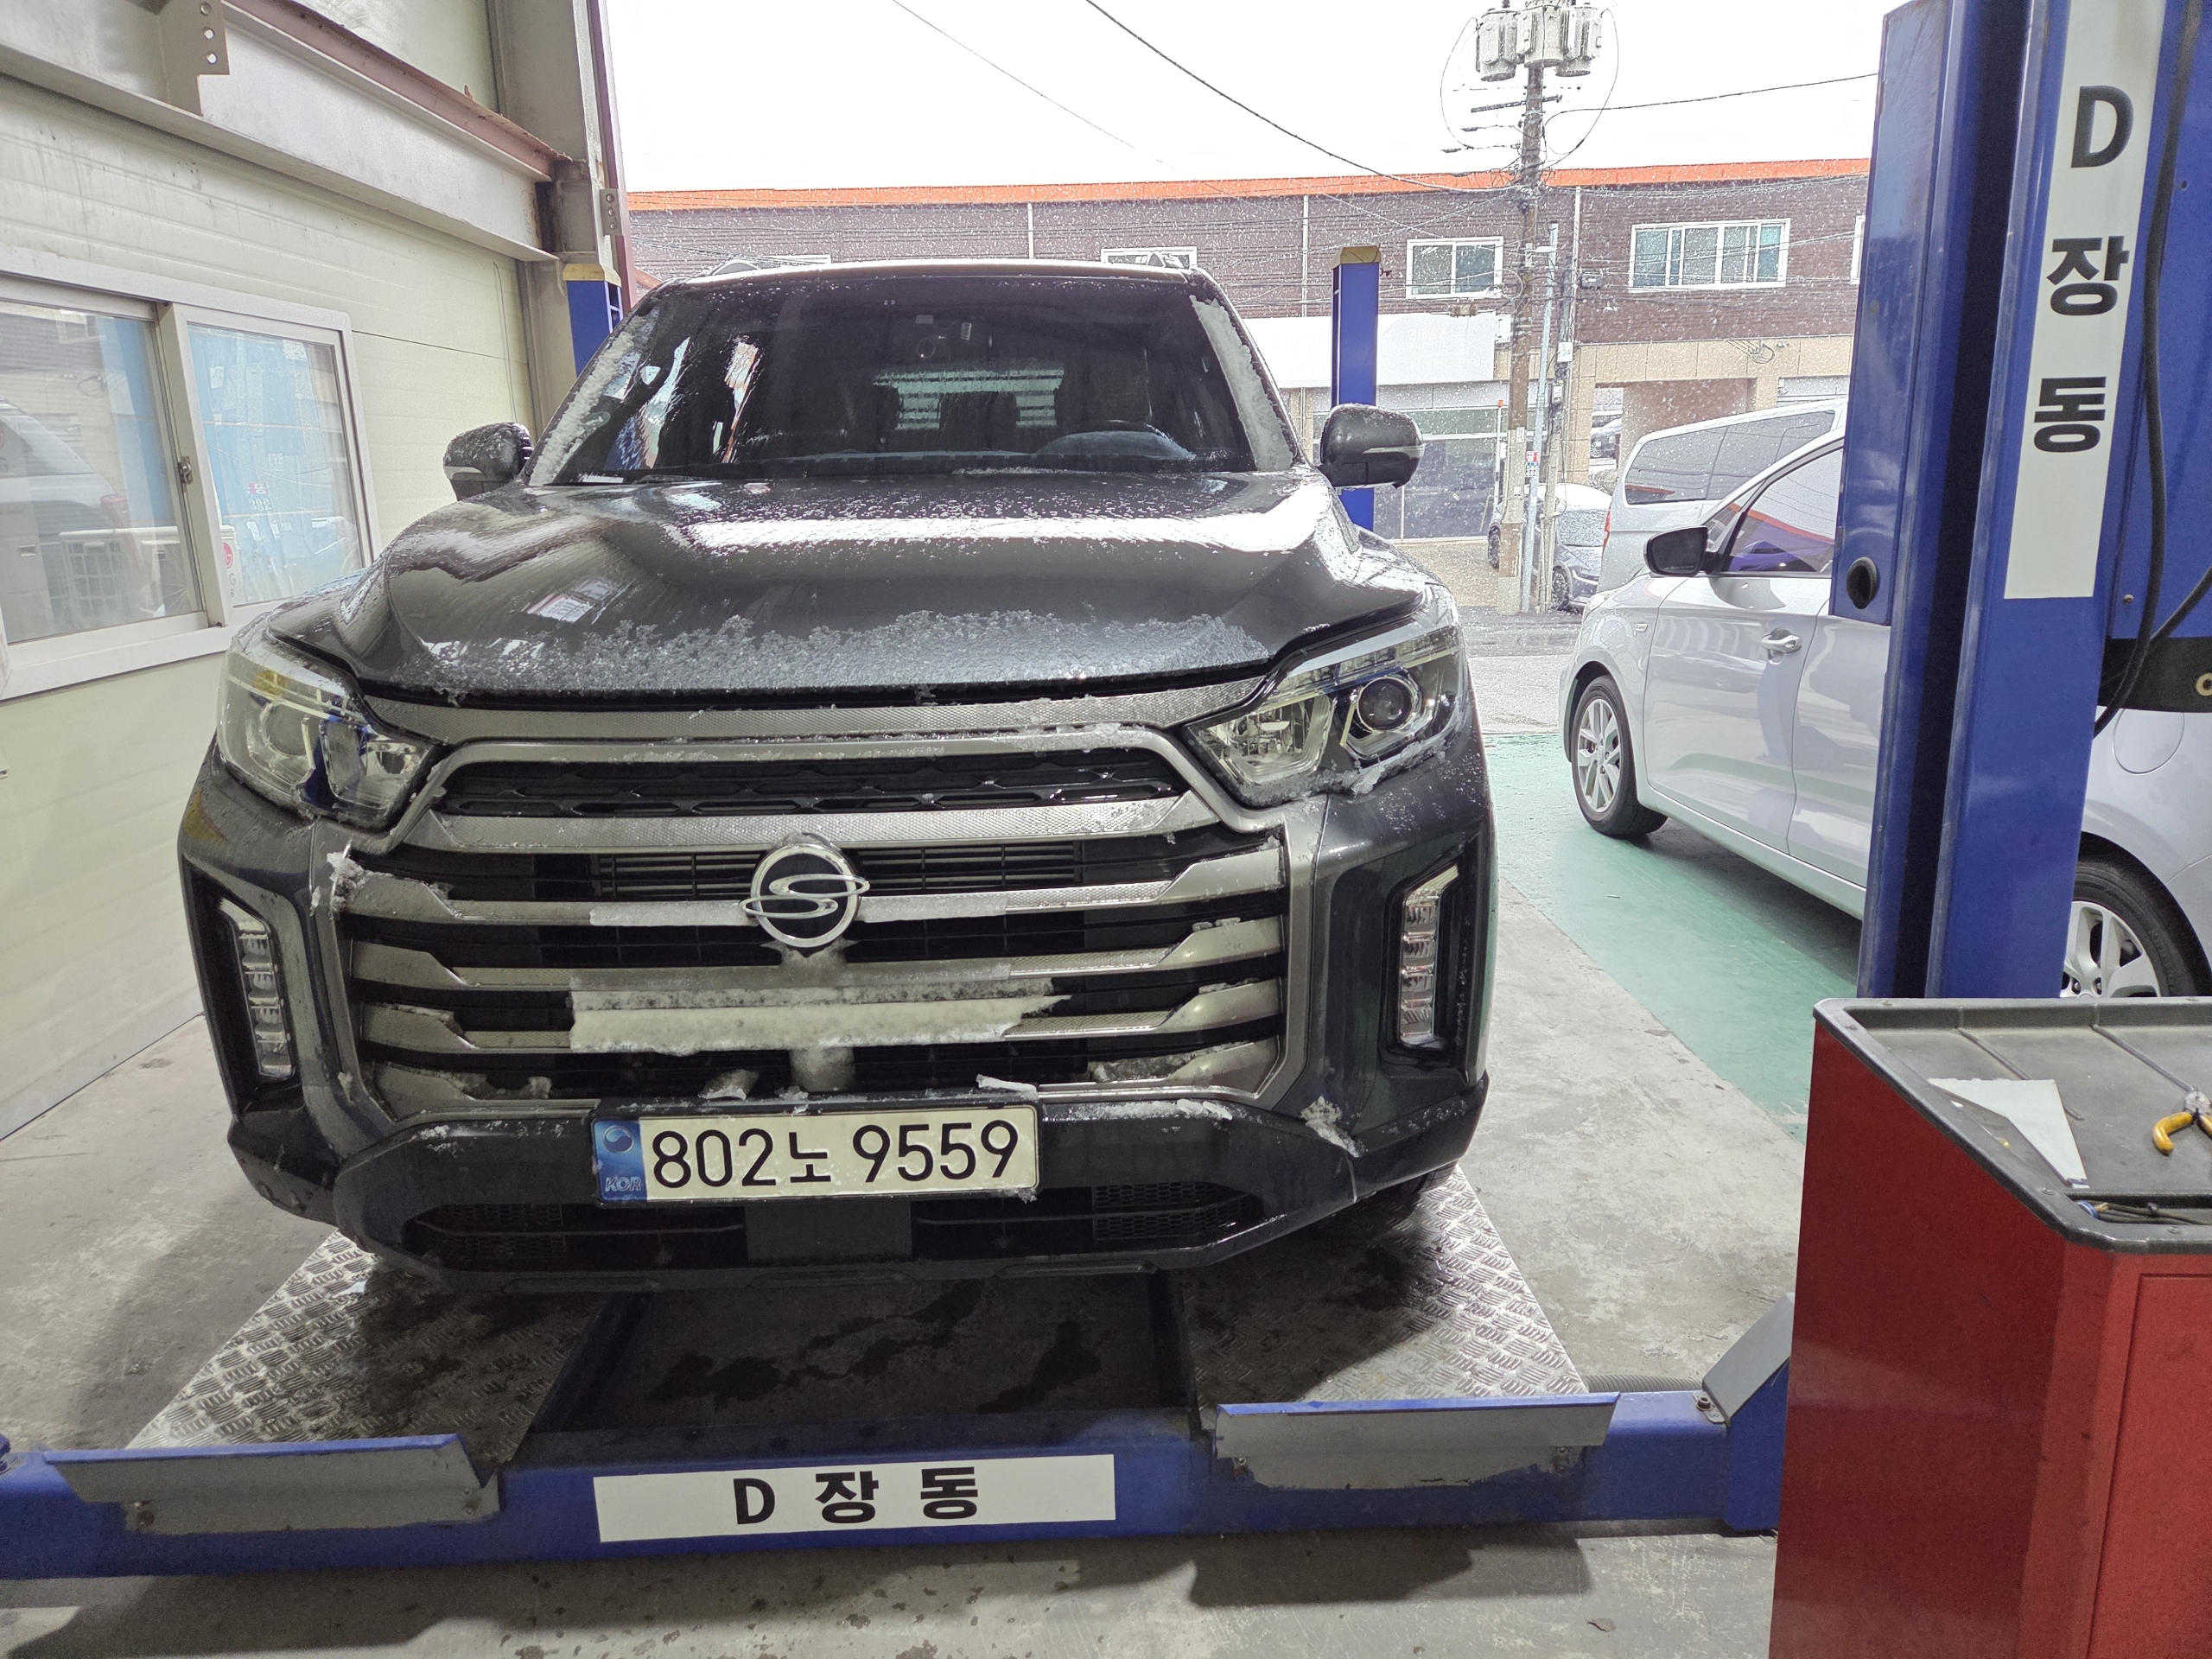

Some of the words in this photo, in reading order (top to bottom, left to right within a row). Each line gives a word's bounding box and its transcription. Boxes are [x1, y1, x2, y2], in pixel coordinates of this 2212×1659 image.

[652, 1128, 831, 1189] 802노
[852, 1119, 1019, 1184] 9559
[605, 1176, 642, 1192] KOR
